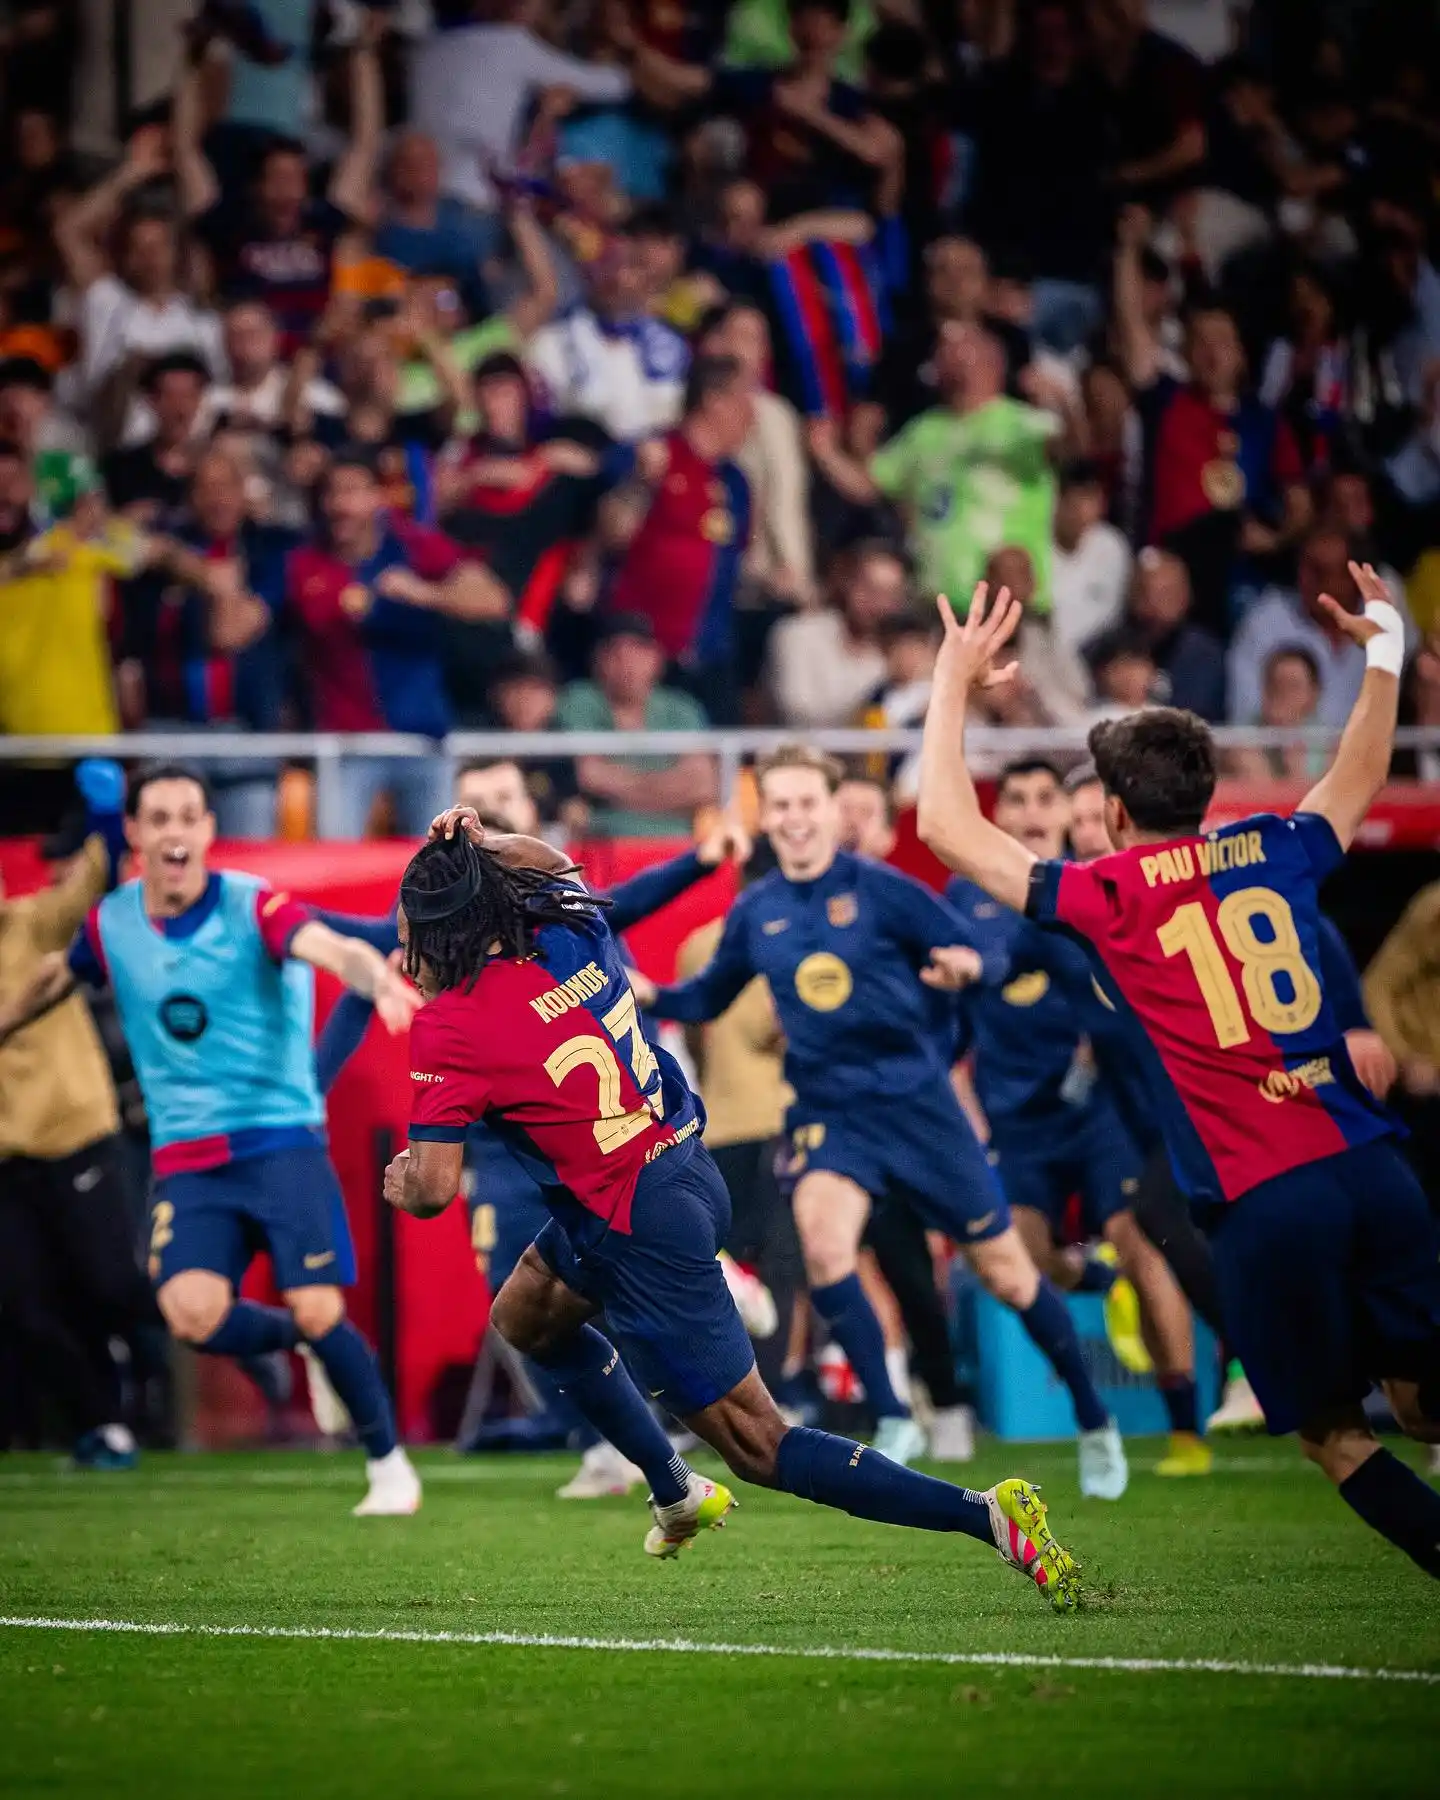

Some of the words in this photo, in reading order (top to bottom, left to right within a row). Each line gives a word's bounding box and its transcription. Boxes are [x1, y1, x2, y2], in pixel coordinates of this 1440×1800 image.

[1139, 845, 1196, 888] PAU
[529, 961, 609, 1024] KOUNDE
[1156, 886, 1322, 1049] 18
[434, 1074, 445, 1083] tv
